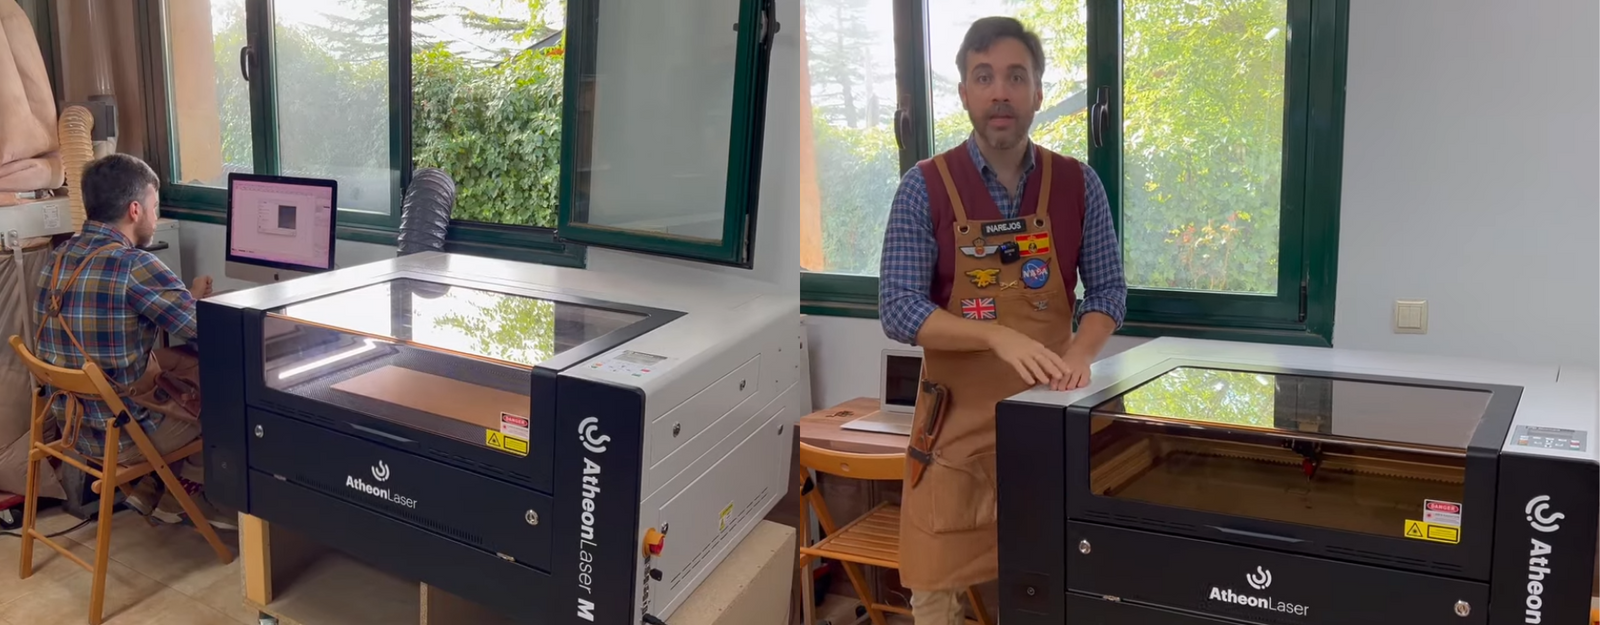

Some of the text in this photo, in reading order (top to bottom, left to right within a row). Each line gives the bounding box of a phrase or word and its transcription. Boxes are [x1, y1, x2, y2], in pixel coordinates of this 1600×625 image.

[986, 222, 1021, 233] INAREJOS
[1023, 267, 1048, 278] NASA
[346, 475, 417, 509] AtheonLaser
[577, 457, 601, 621] AtheonLaser M
[1525, 538, 1552, 624] Atheon
[1209, 587, 1309, 616] AtheonLaser
